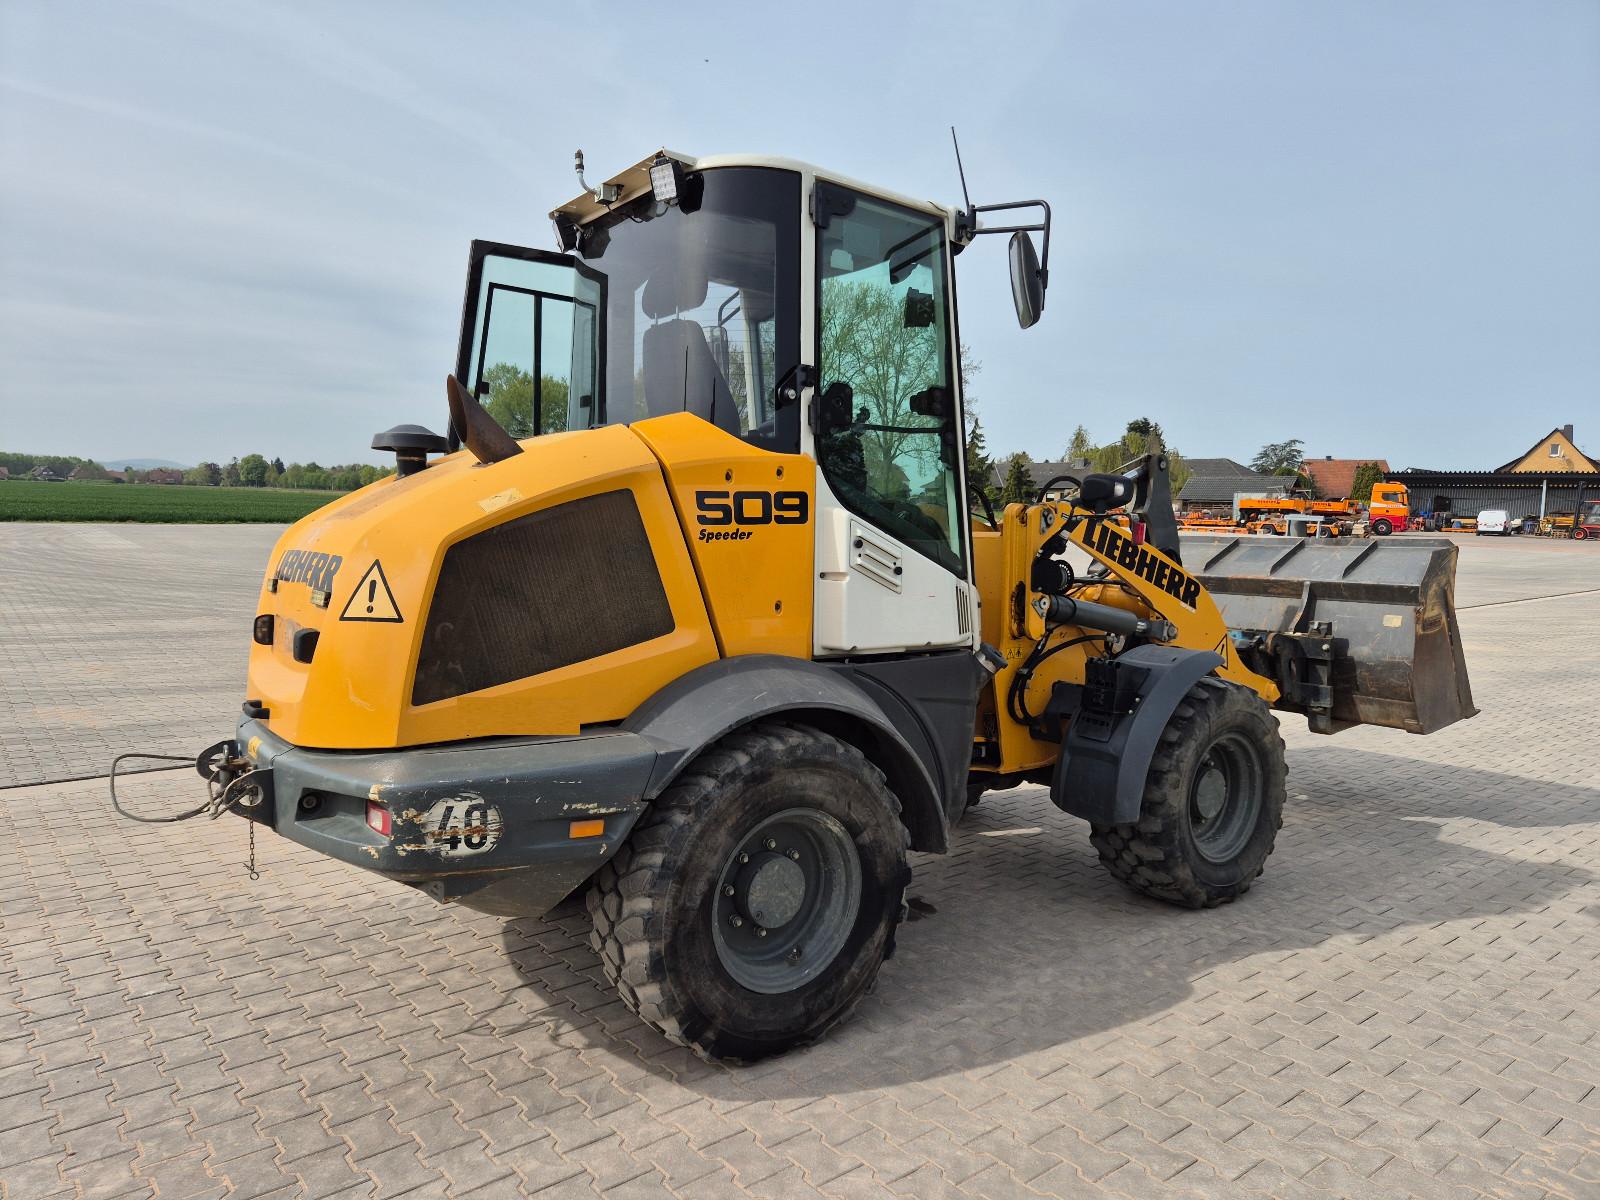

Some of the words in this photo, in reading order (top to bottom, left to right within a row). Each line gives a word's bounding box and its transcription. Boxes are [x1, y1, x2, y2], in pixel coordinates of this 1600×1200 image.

[696, 491, 808, 525] 509
[699, 528, 752, 543] Speeder
[1082, 518, 1200, 609] LIEBHERR
[437, 804, 489, 850] 40
